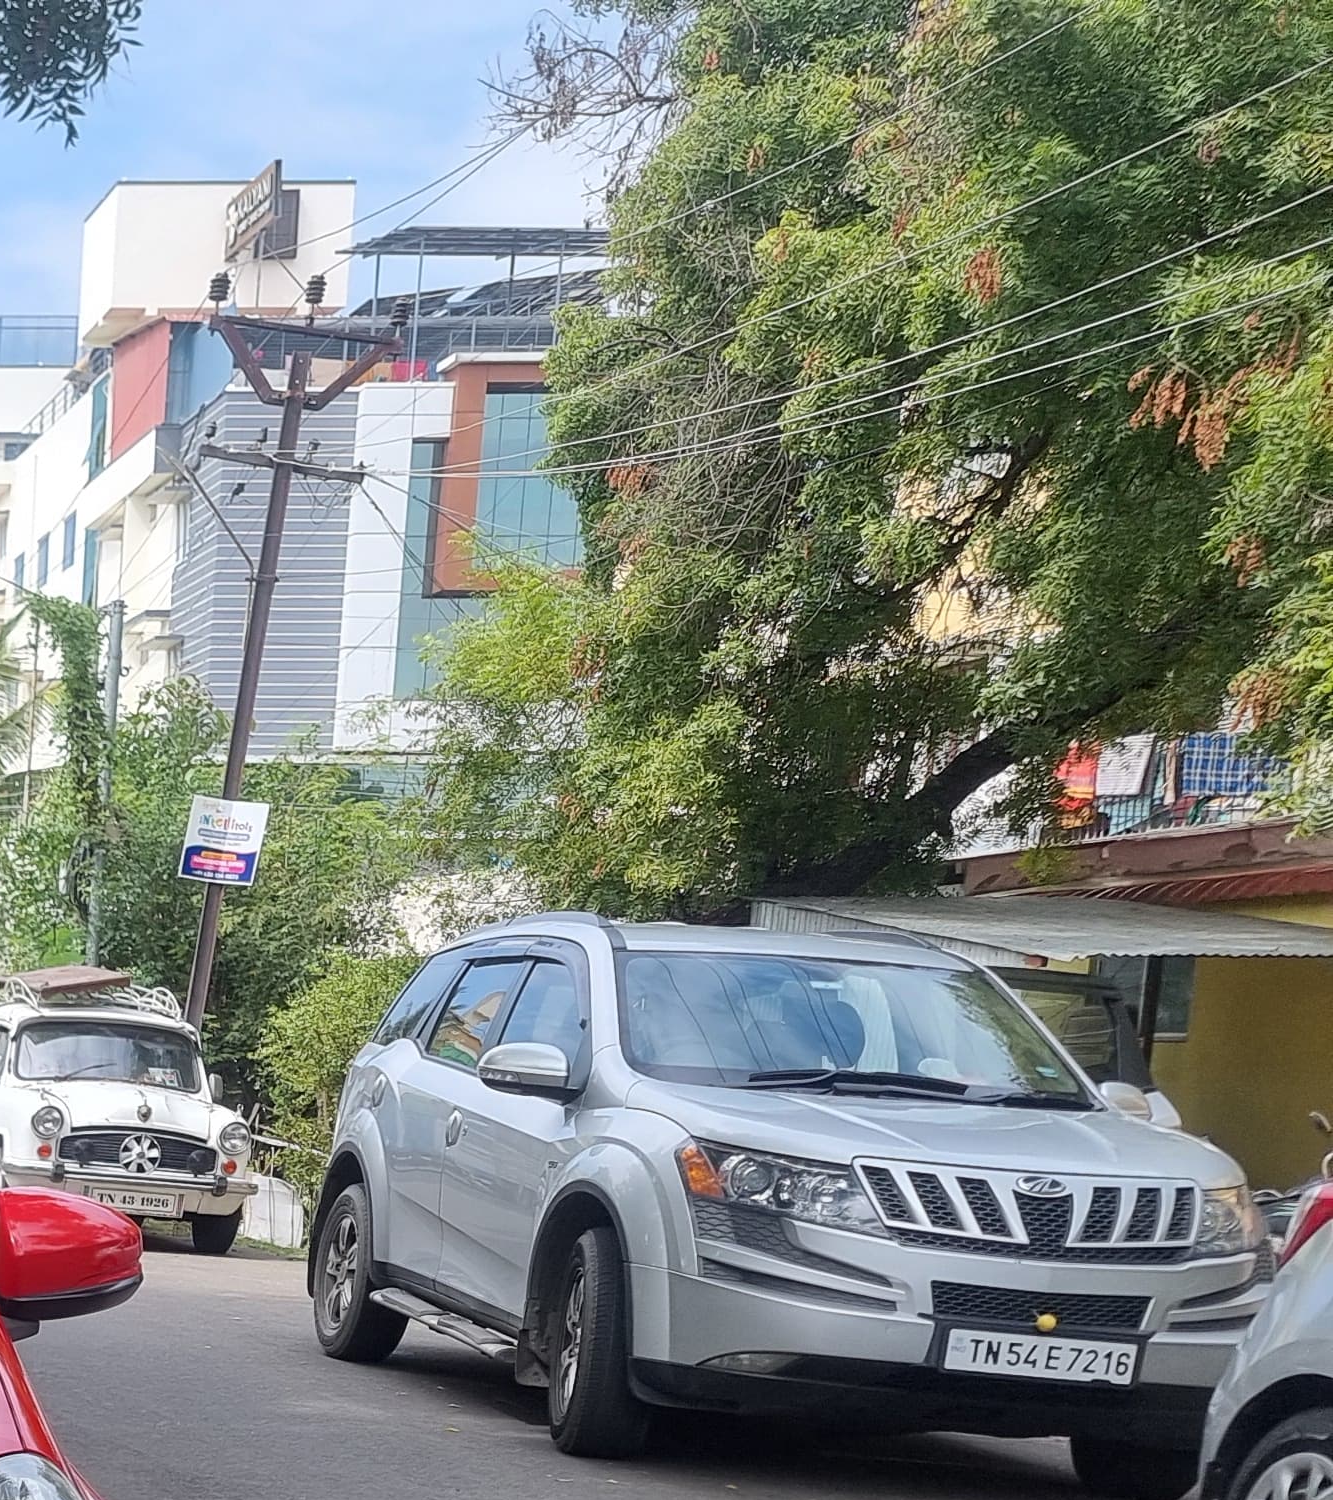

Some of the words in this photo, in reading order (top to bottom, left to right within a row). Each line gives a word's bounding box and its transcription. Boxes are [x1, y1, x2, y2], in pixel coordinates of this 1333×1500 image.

[97, 1193, 115, 1204] TN
[120, 1195, 135, 1206] 43
[140, 1197, 170, 1209] 1926
